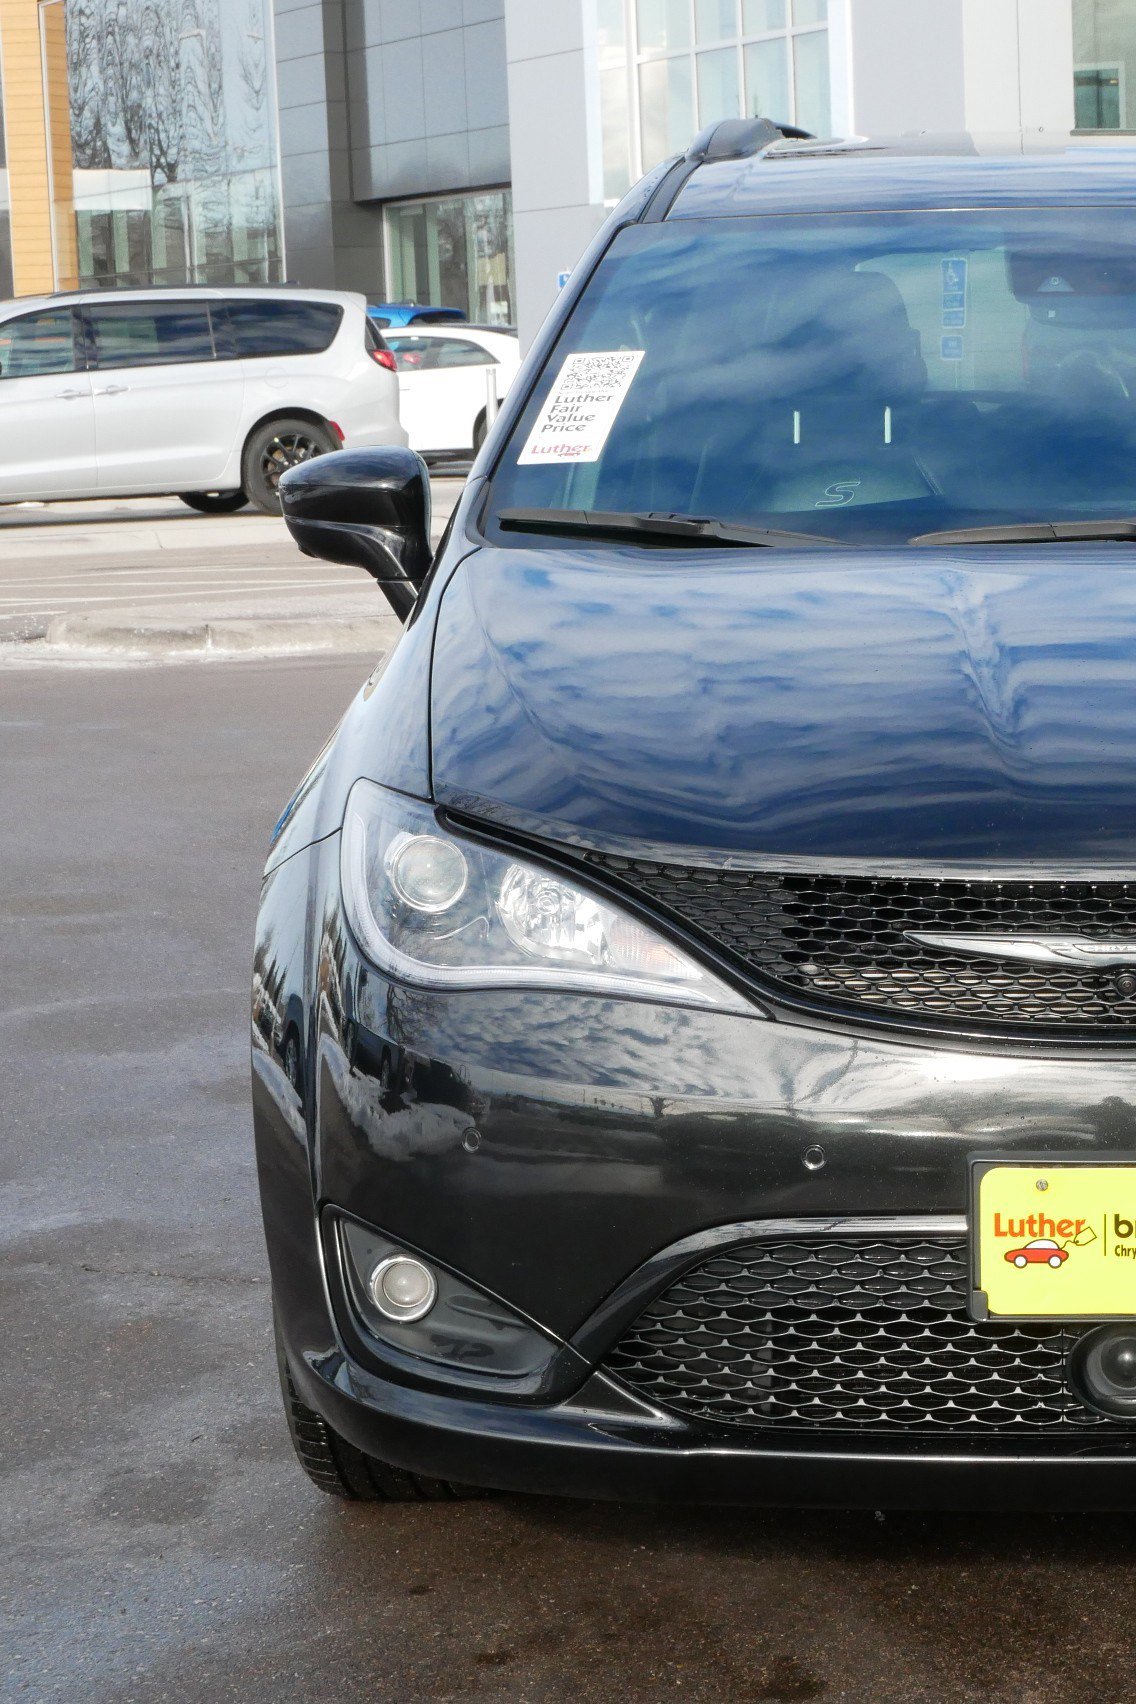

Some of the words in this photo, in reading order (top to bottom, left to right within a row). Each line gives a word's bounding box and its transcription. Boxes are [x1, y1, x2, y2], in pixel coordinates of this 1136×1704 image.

[554, 394, 614, 404] Luther
[550, 404, 582, 414] Fair
[547, 413, 596, 423] Value
[541, 423, 587, 433] Price
[531, 443, 590, 455] Luther
[994, 1212, 1086, 1238] Luther
